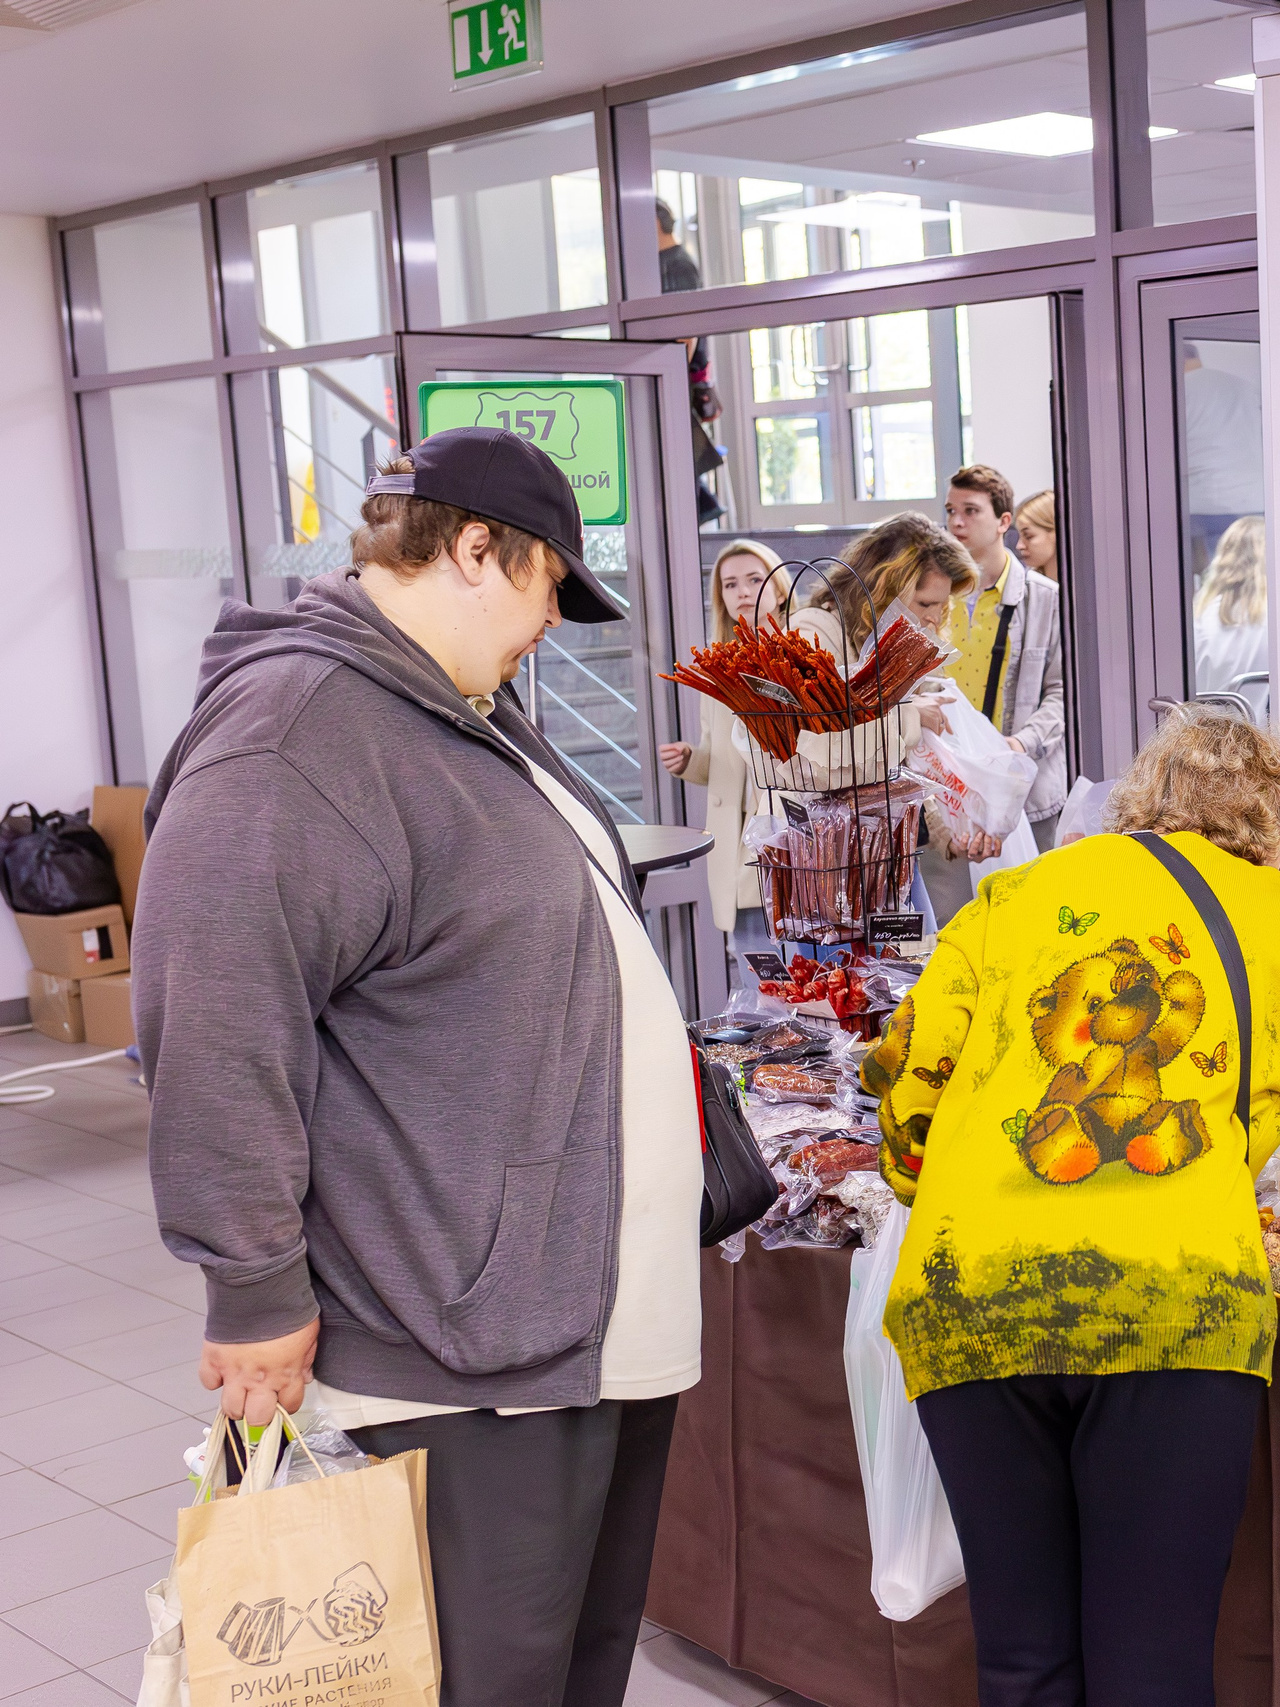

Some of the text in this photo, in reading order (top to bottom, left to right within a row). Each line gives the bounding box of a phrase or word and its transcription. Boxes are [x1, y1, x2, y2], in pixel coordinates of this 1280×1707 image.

[496, 410, 556, 441] 157
[230, 1651, 389, 1704] РУКИ-ЛЕЙКИ
[304, 1677, 392, 1707] РАСТЕНИЯ
